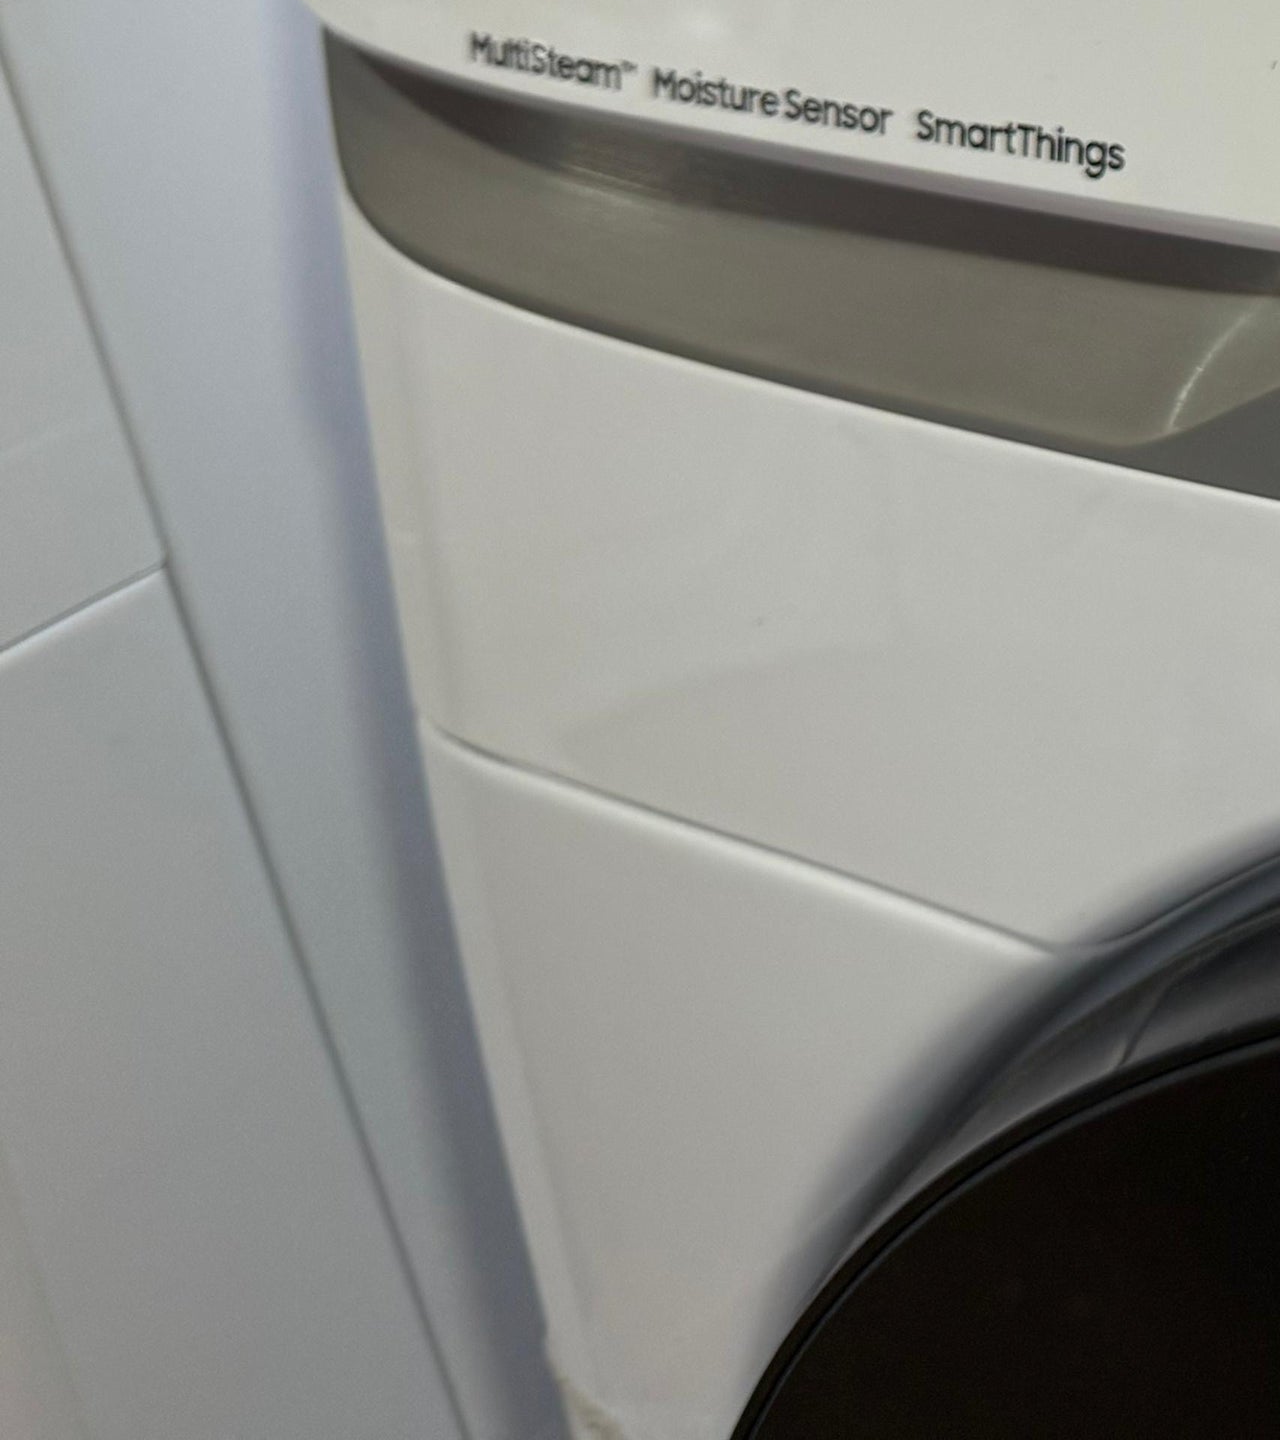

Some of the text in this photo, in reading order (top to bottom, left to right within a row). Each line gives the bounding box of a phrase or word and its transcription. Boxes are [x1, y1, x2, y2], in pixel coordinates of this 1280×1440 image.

[652, 67, 893, 136] Moisture Sensor
[916, 109, 1126, 178] SmartThings
